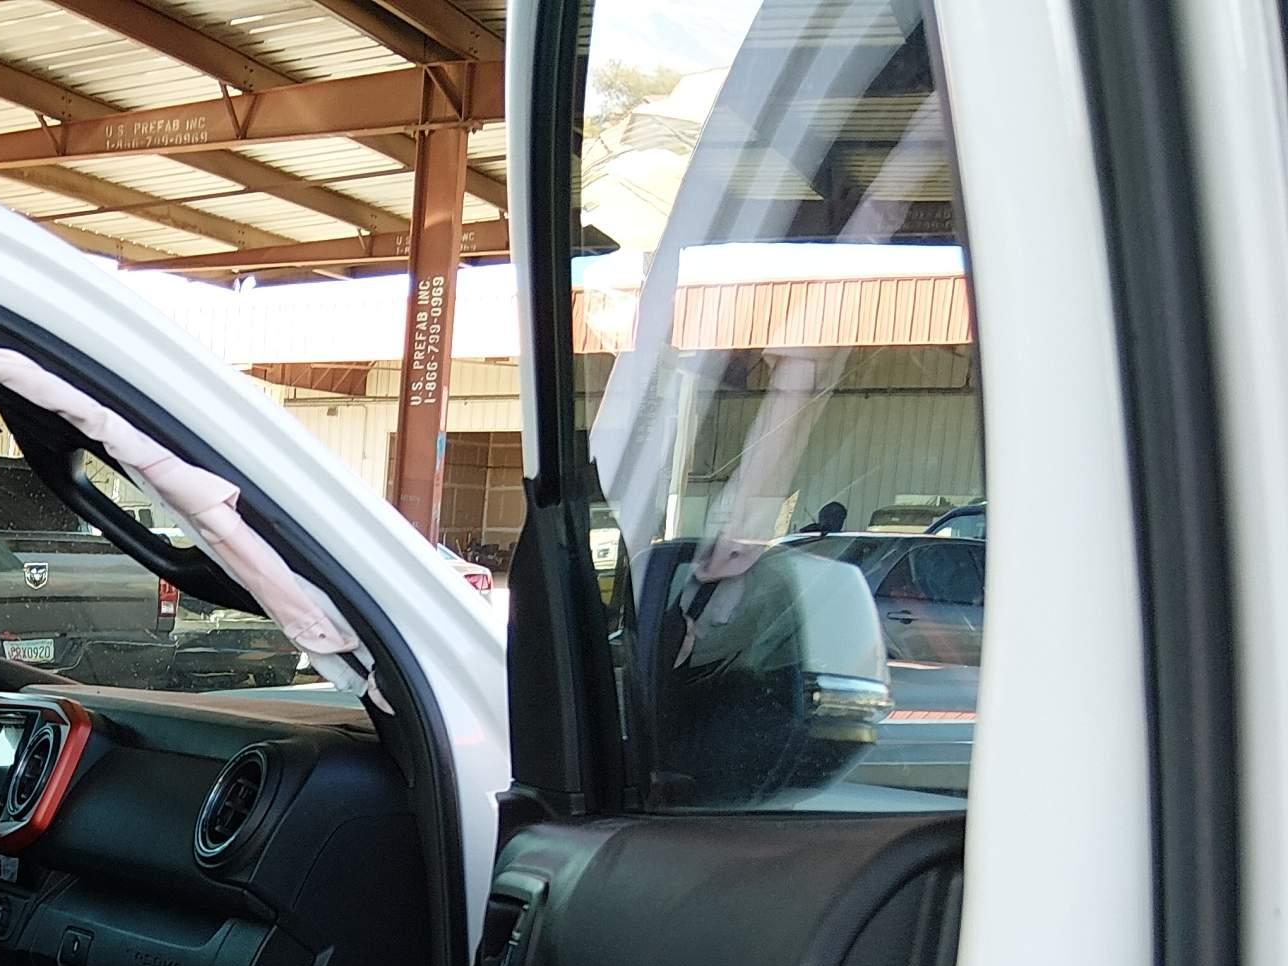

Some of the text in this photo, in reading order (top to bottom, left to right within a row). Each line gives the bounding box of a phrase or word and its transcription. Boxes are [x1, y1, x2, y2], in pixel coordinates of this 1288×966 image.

[133, 119, 181, 136] PREFAB
[412, 311, 429, 370] PREFAB
[424, 275, 445, 405] 1-866-799-0969
